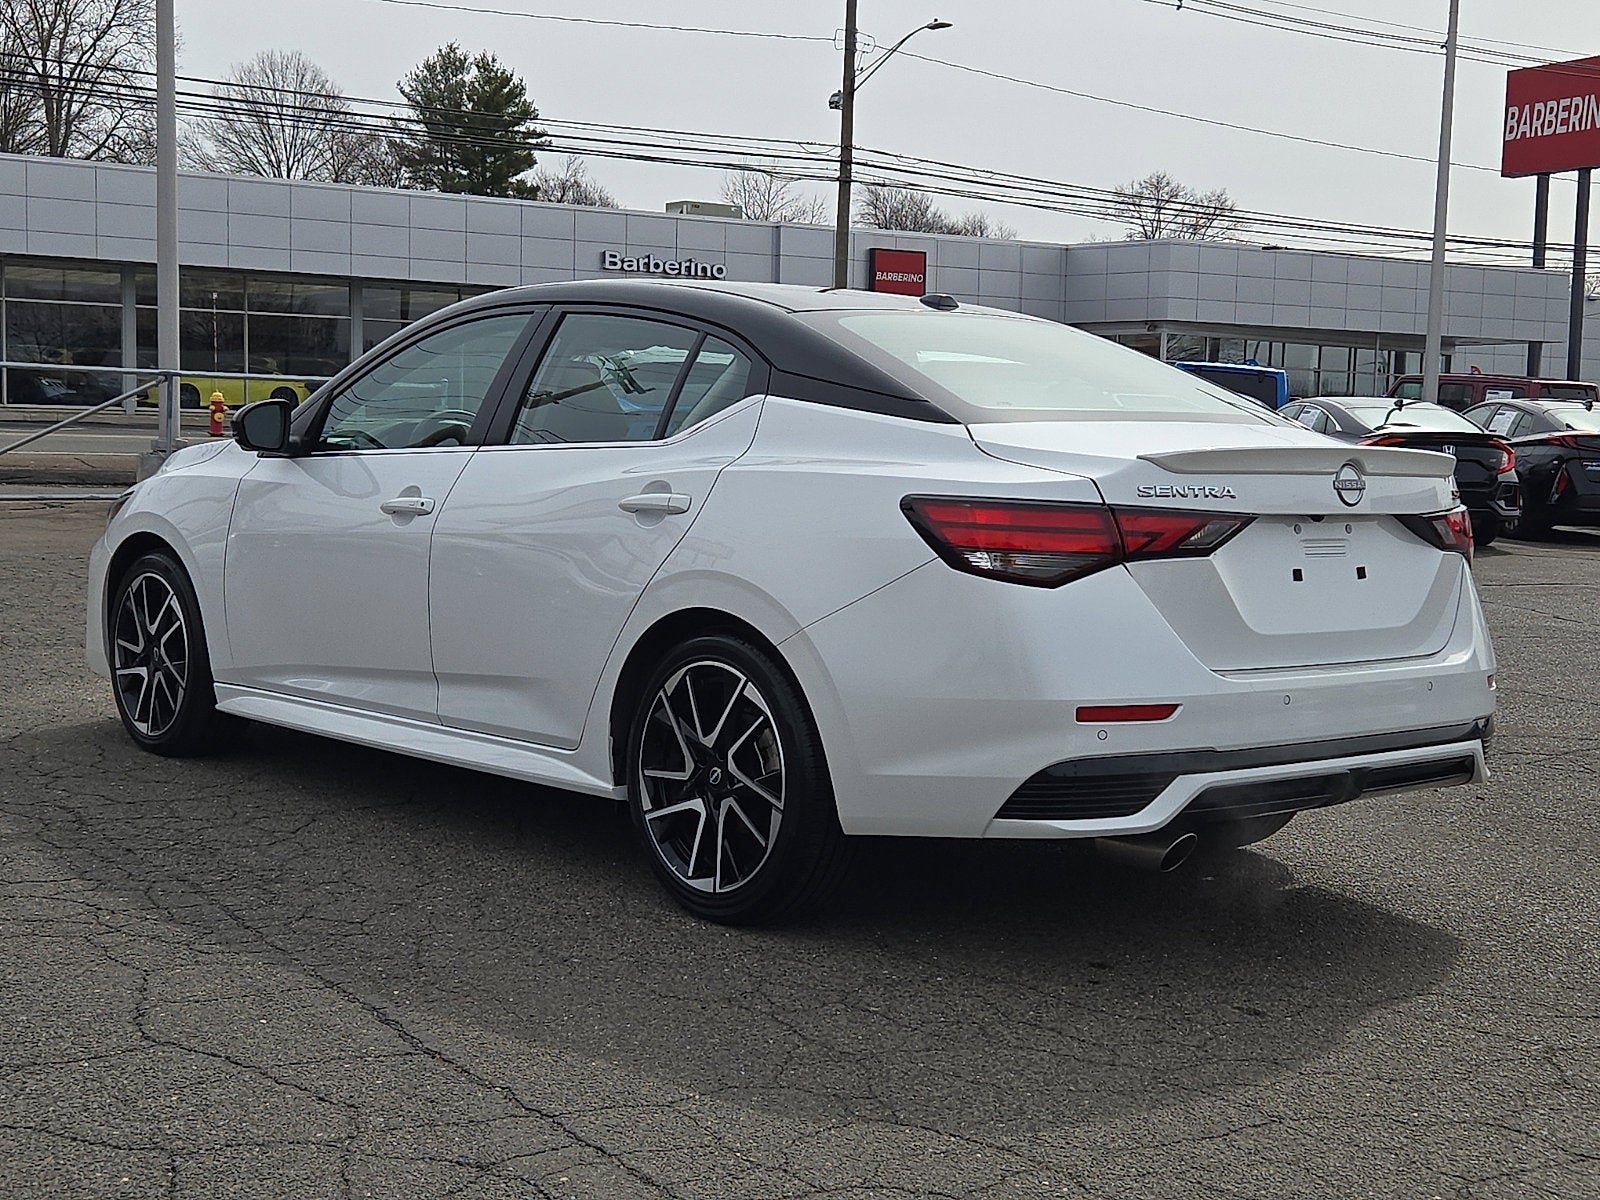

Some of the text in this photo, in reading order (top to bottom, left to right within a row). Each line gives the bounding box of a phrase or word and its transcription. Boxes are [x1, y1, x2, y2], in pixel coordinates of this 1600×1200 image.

[603, 250, 727, 278] Barberino
[876, 272, 923, 283] BARBERINO
[1137, 485, 1236, 499] SENTRA
